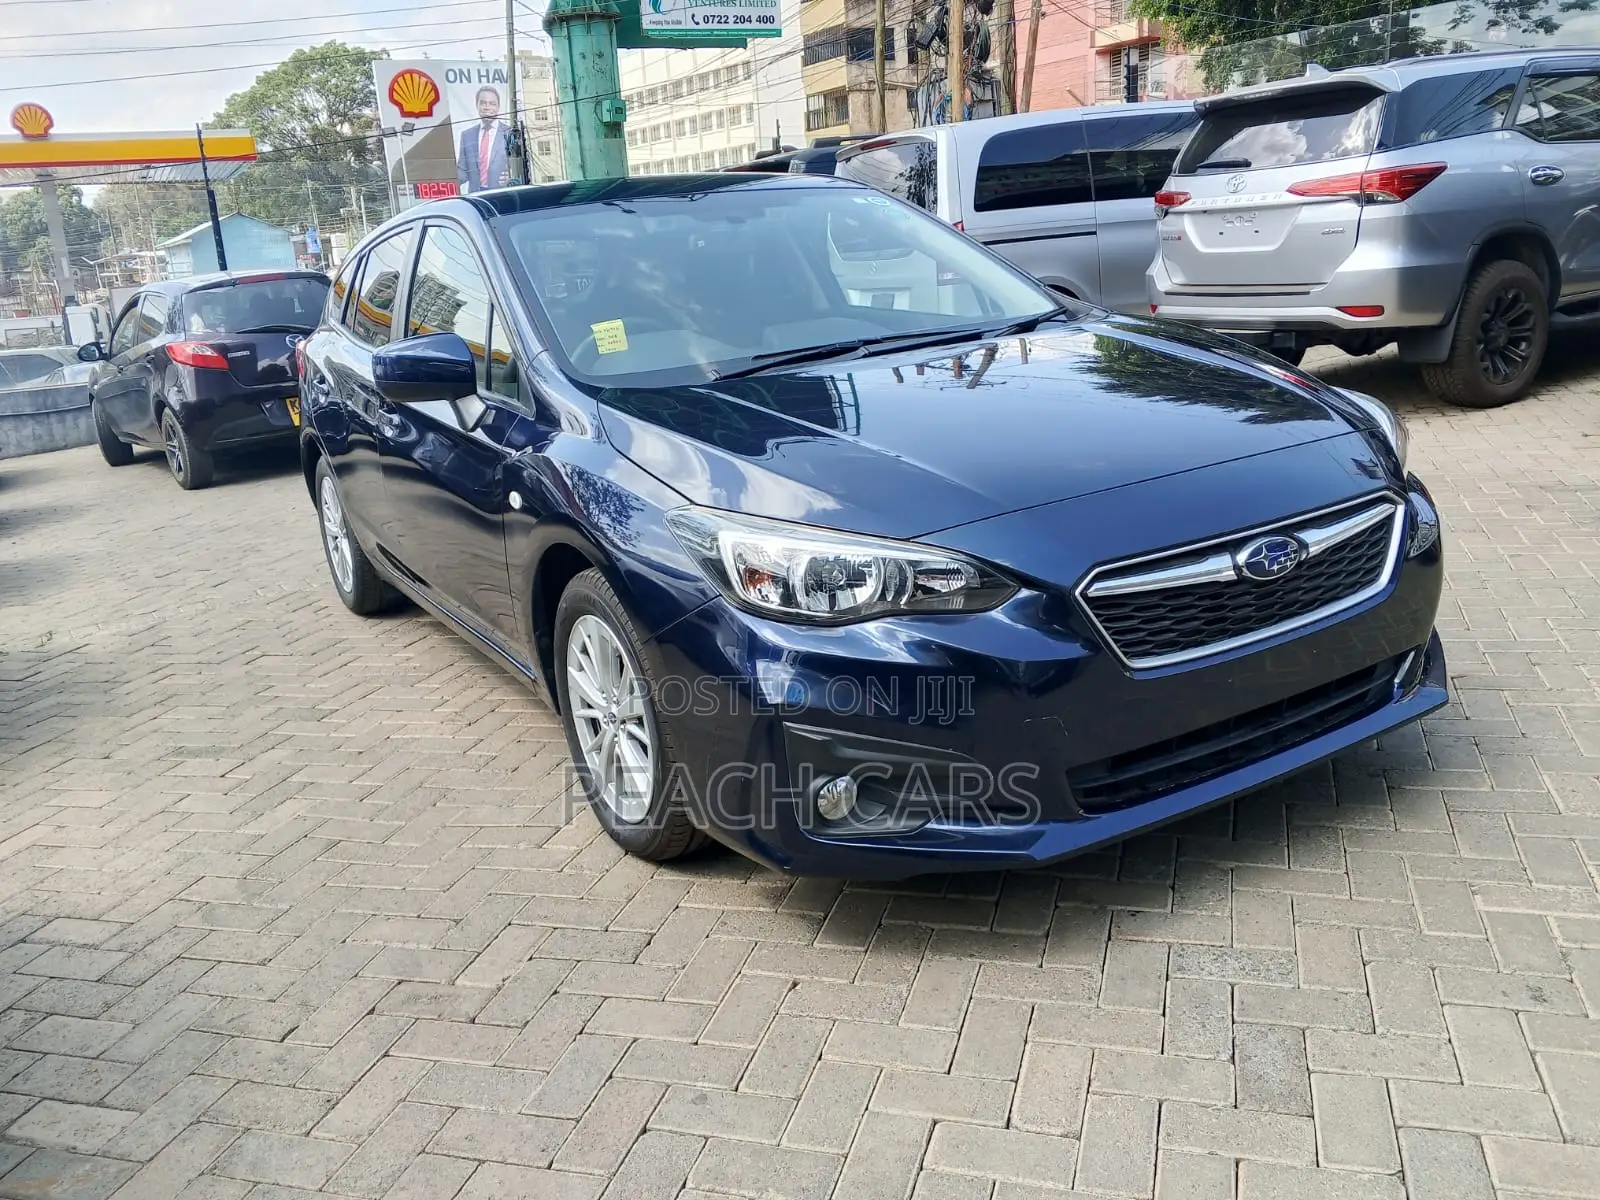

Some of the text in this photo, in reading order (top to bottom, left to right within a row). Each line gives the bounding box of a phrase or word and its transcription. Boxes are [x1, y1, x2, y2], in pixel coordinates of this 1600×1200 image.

[739, 0, 777, 8] LIMITED
[703, 14, 775, 24] 0722 204 400
[445, 68, 472, 84] ON
